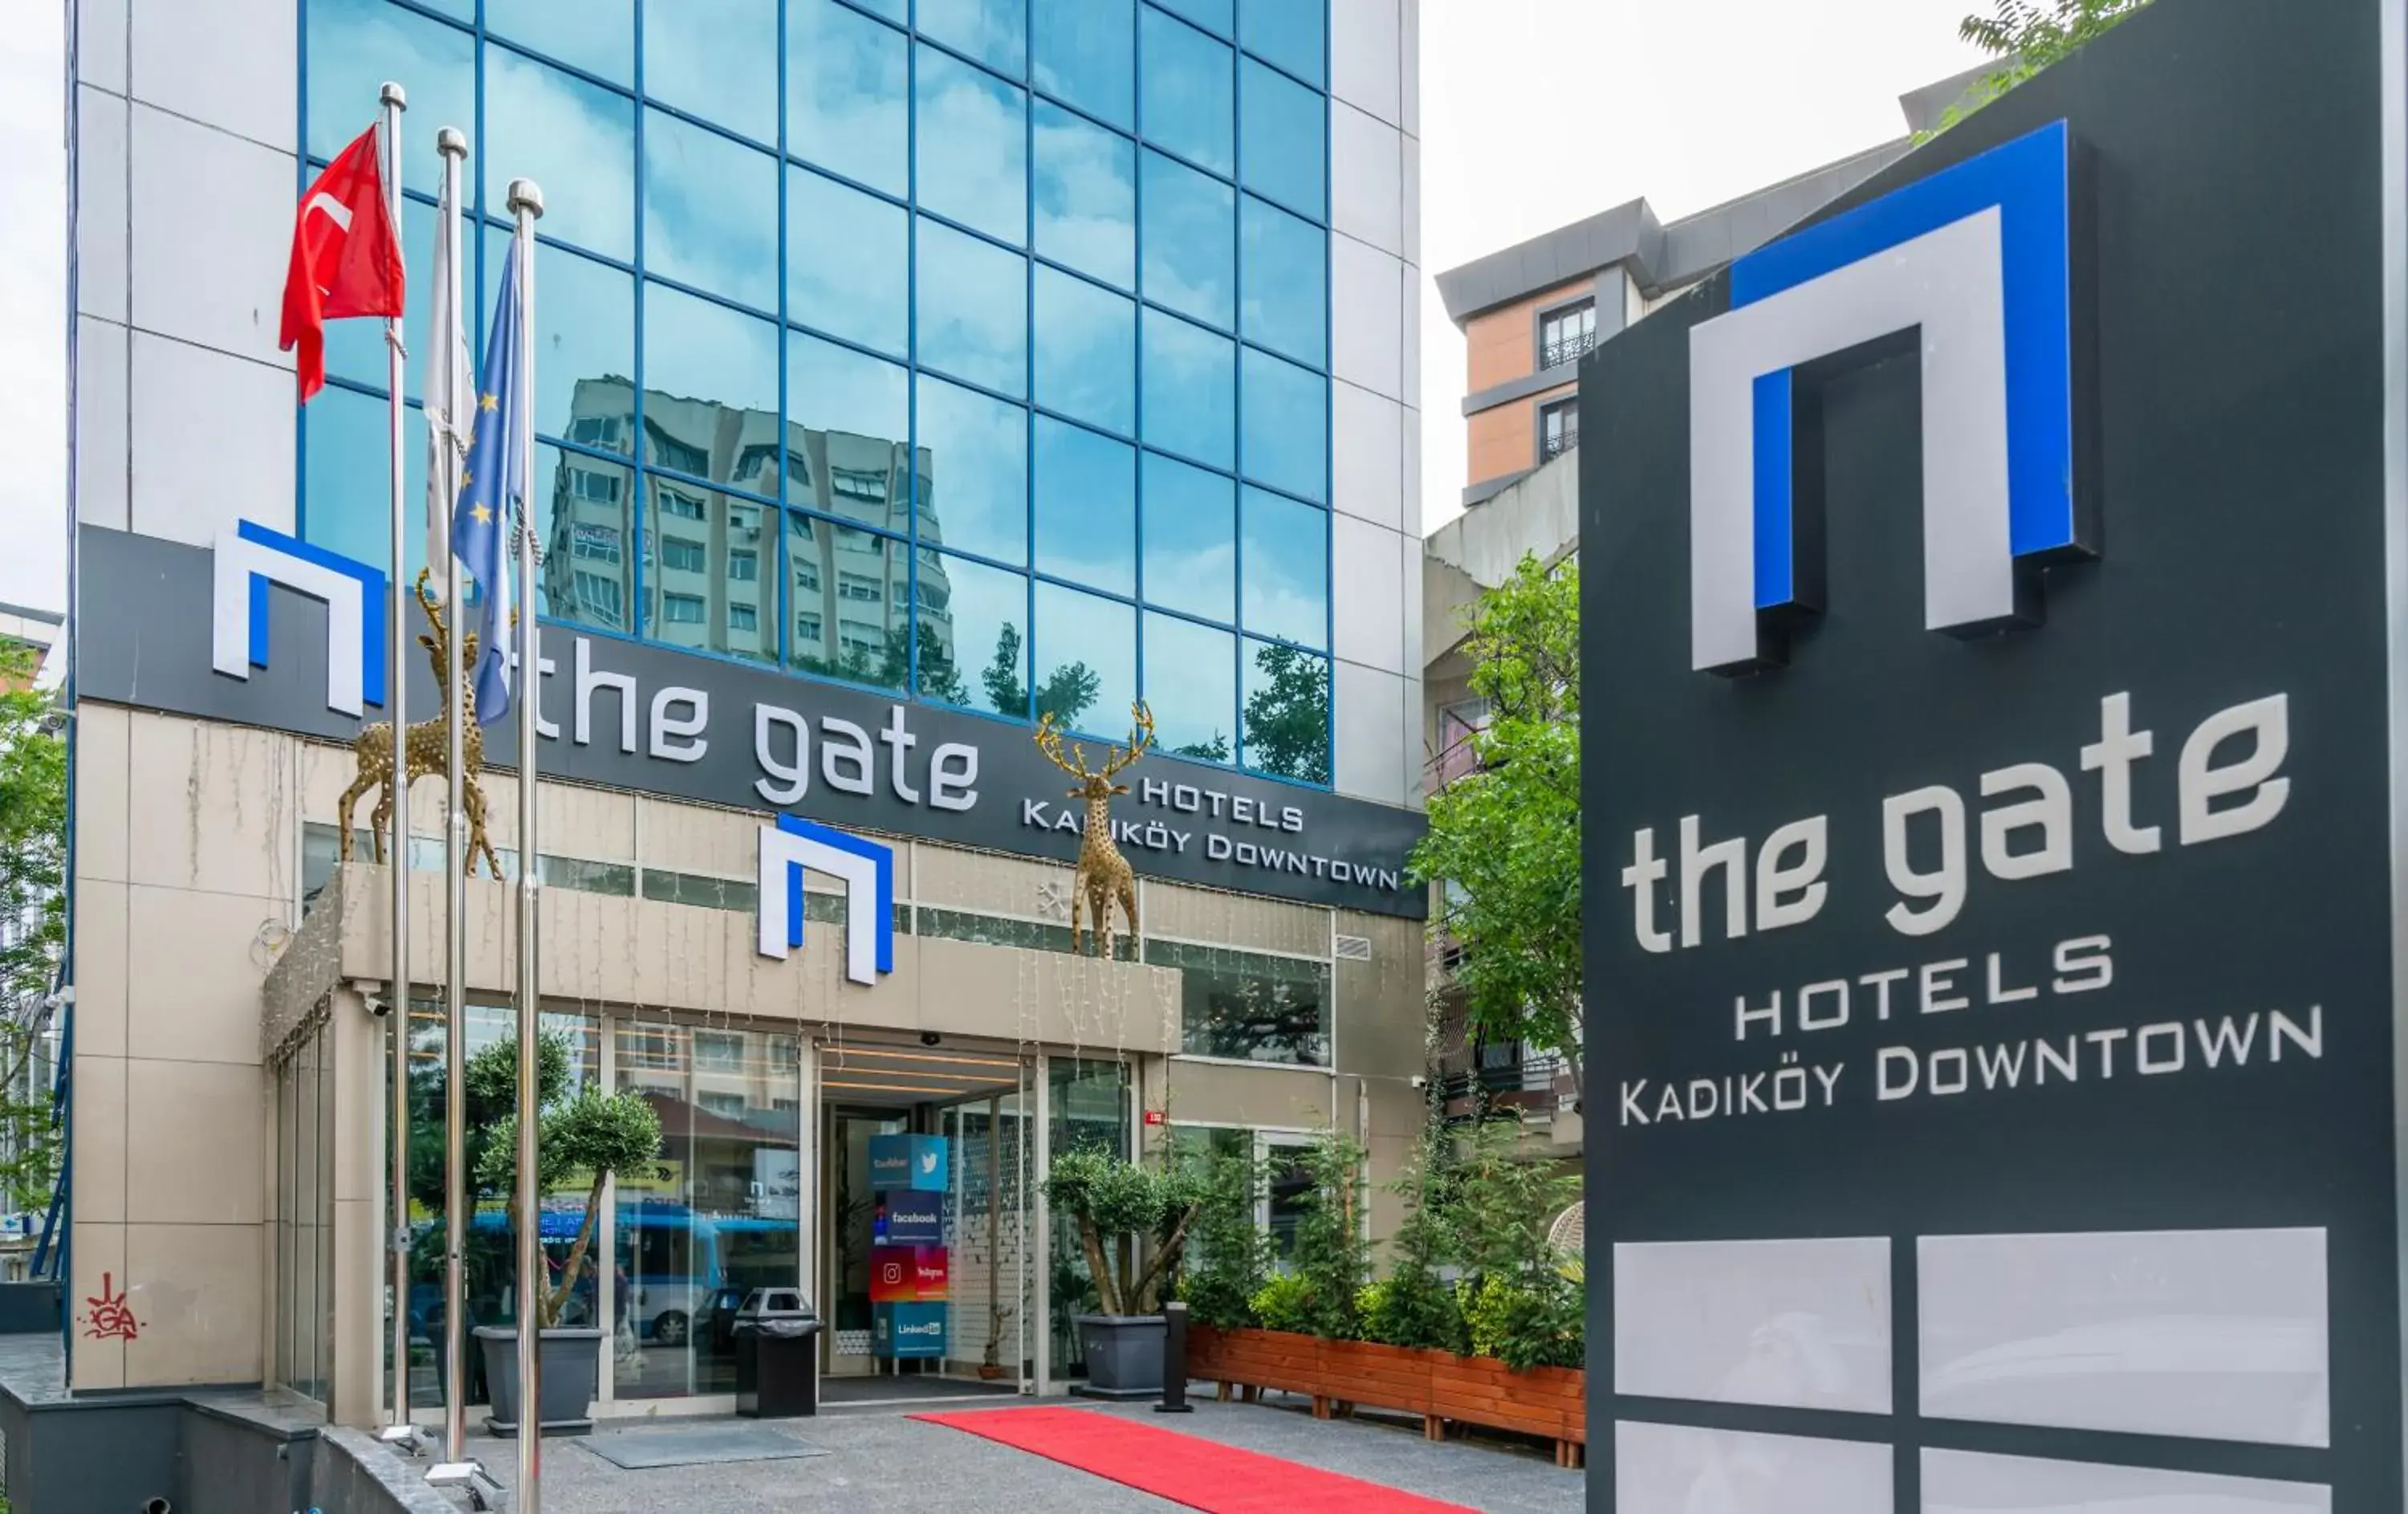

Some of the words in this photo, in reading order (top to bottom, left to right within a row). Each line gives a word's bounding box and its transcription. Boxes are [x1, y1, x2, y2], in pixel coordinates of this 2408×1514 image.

[510, 628, 710, 763] the
[754, 701, 979, 811] gate
[1023, 797, 1192, 853] KAIKÖY
[1207, 832, 1399, 890] DOWNTOWN
[1142, 775, 1304, 832] HOTELS
[1621, 813, 1828, 954] the
[1881, 690, 2292, 937] gate
[1735, 934, 2114, 1042] HOTELS
[1620, 1051, 1845, 1126] KADIKÖY
[1877, 1004, 2323, 1101] DOWNTOWN
[892, 1211, 937, 1223] facebook
